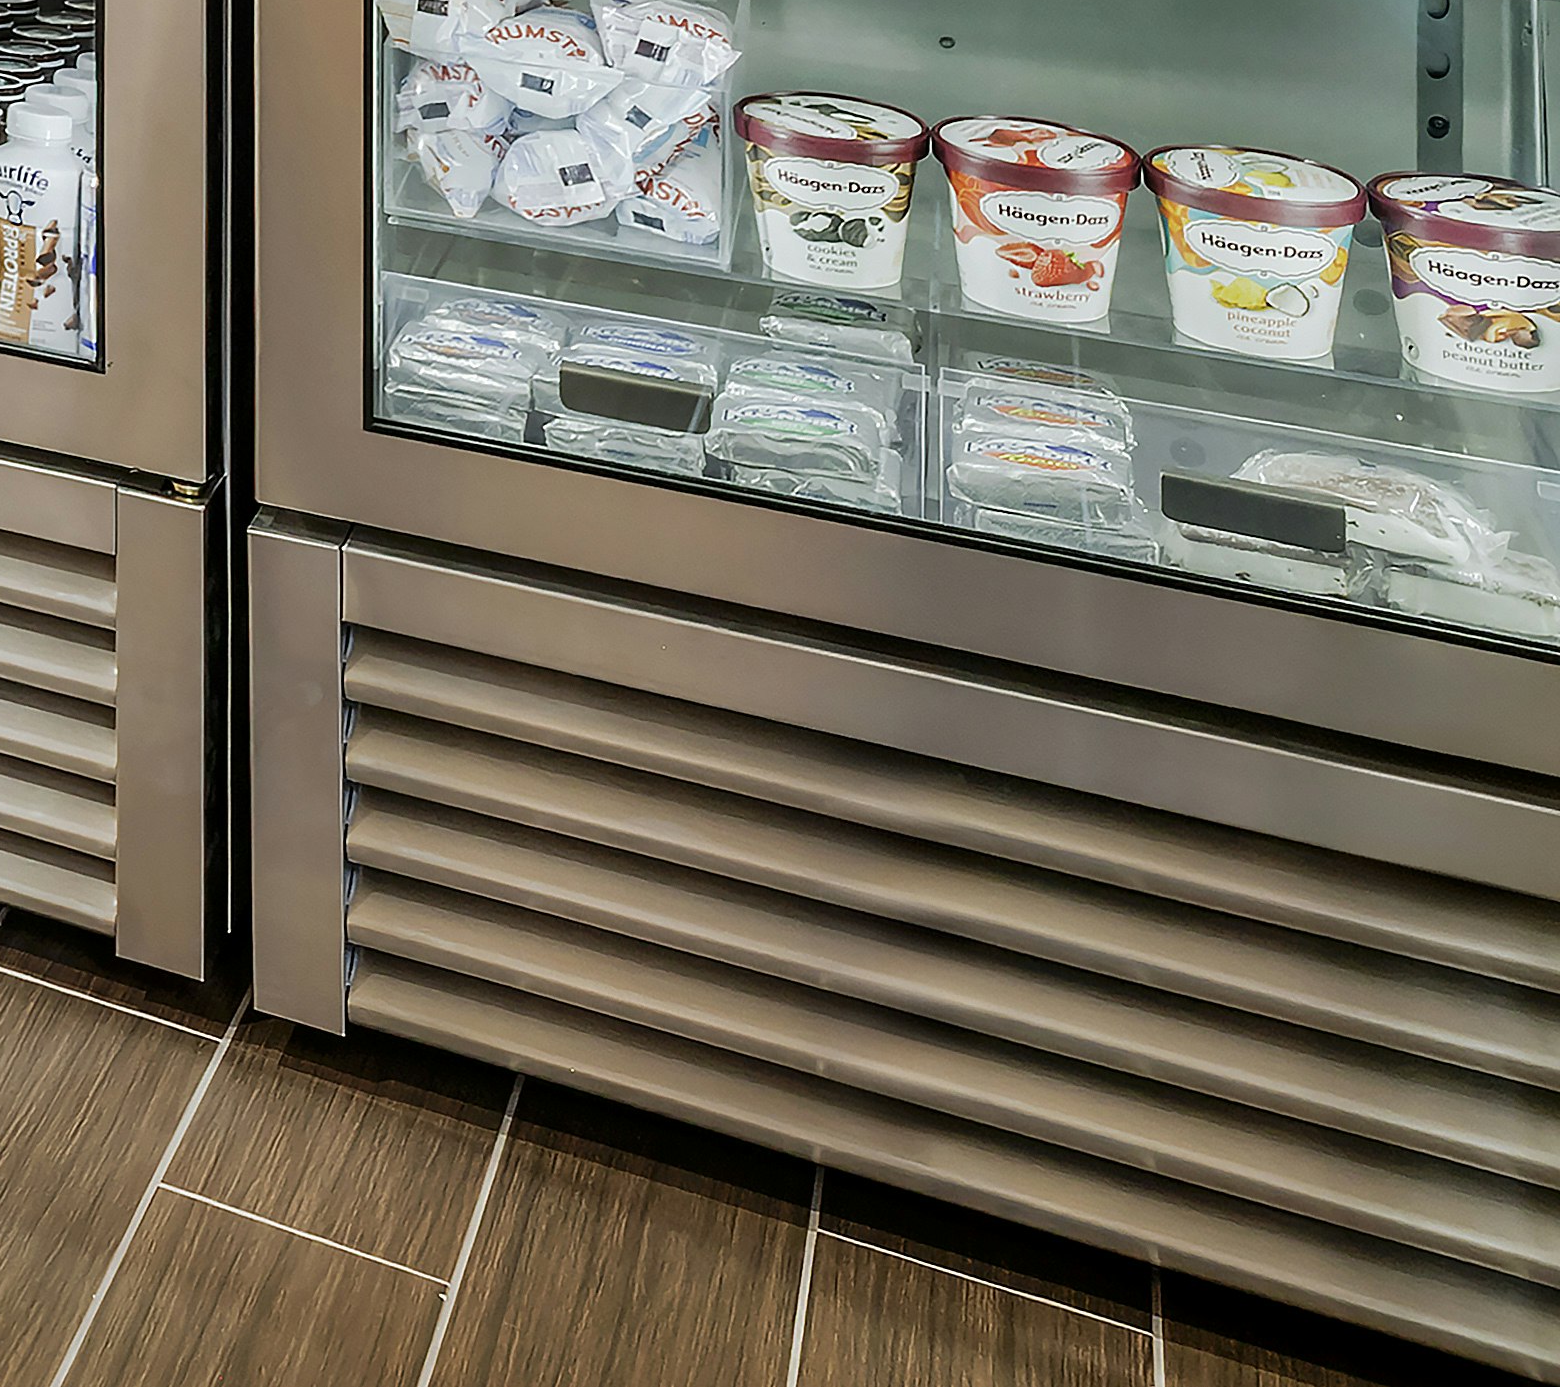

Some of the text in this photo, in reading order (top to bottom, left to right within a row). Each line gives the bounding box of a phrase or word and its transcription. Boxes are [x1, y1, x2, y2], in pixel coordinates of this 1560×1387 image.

[807, 244, 857, 259] cookies
[818, 256, 858, 269] cream
[1015, 286, 1091, 304] strawberry
[1226, 309, 1297, 330] pineapple
[1233, 324, 1291, 339] coconut
[1456, 339, 1533, 360] chocolate
[1442, 347, 1545, 374] peanut butter
